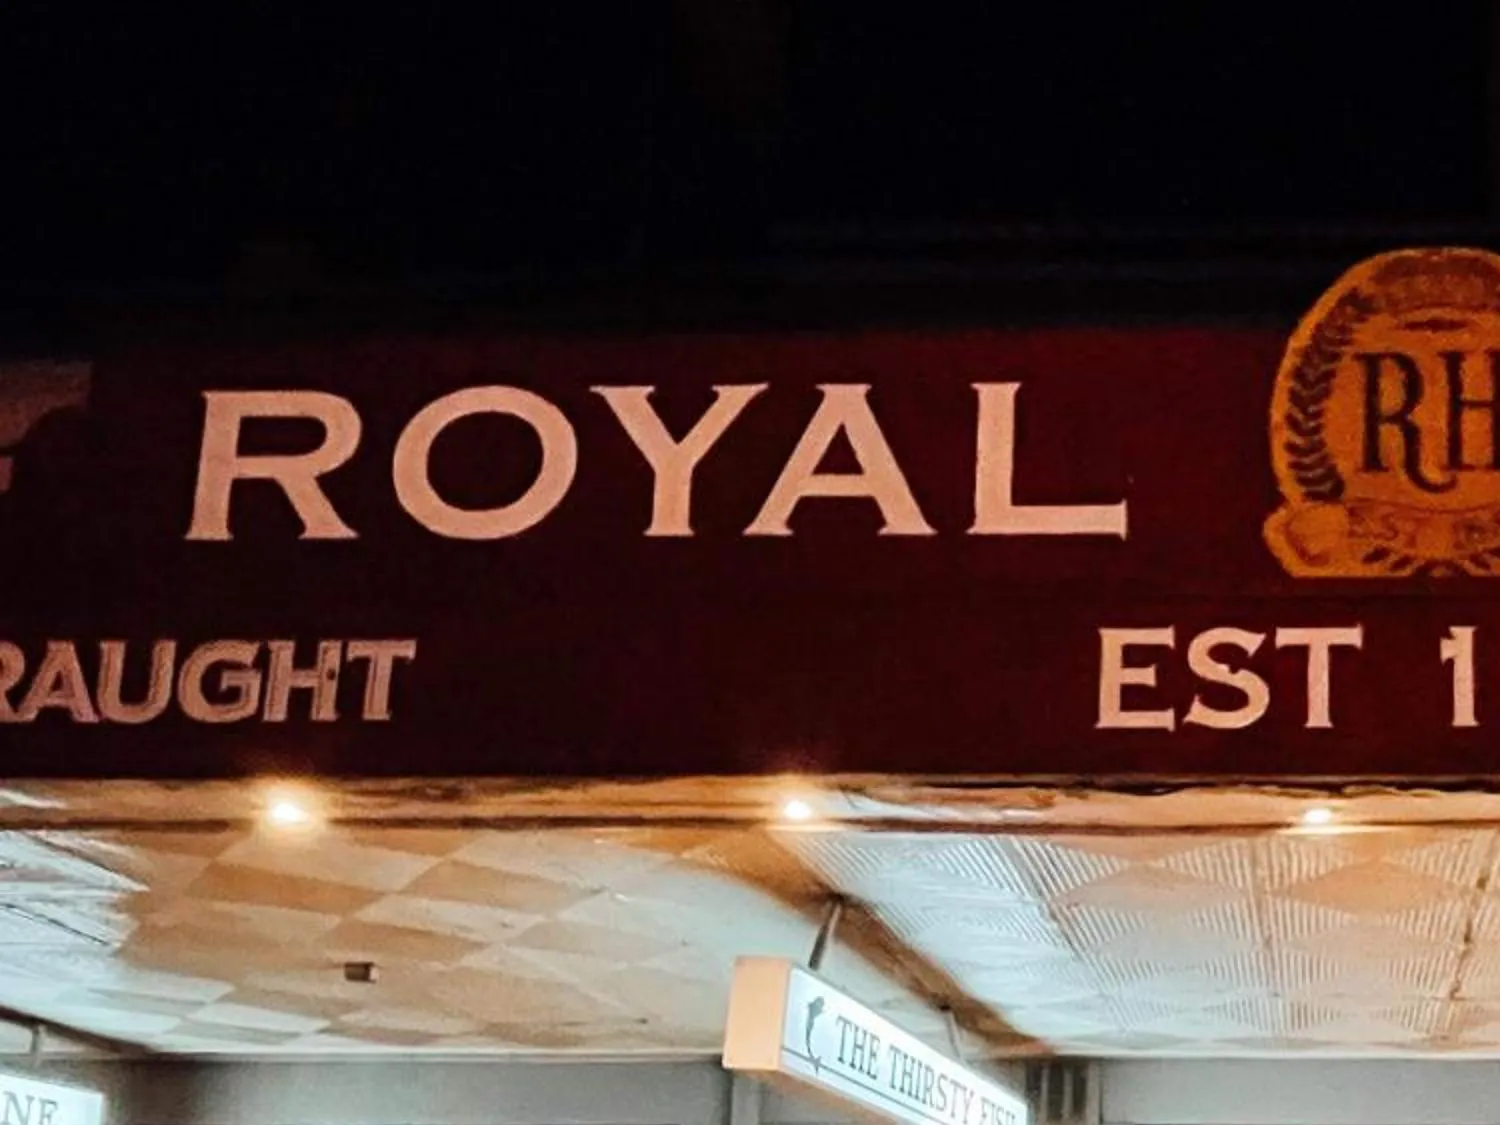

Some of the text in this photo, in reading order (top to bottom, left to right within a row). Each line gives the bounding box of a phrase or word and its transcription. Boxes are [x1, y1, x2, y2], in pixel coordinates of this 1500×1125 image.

[184, 381, 1129, 541] ROYAL
[1095, 623, 1363, 732] EST
[836, 1015, 881, 1081] THE
[890, 1043, 975, 1125] THIRSTY
